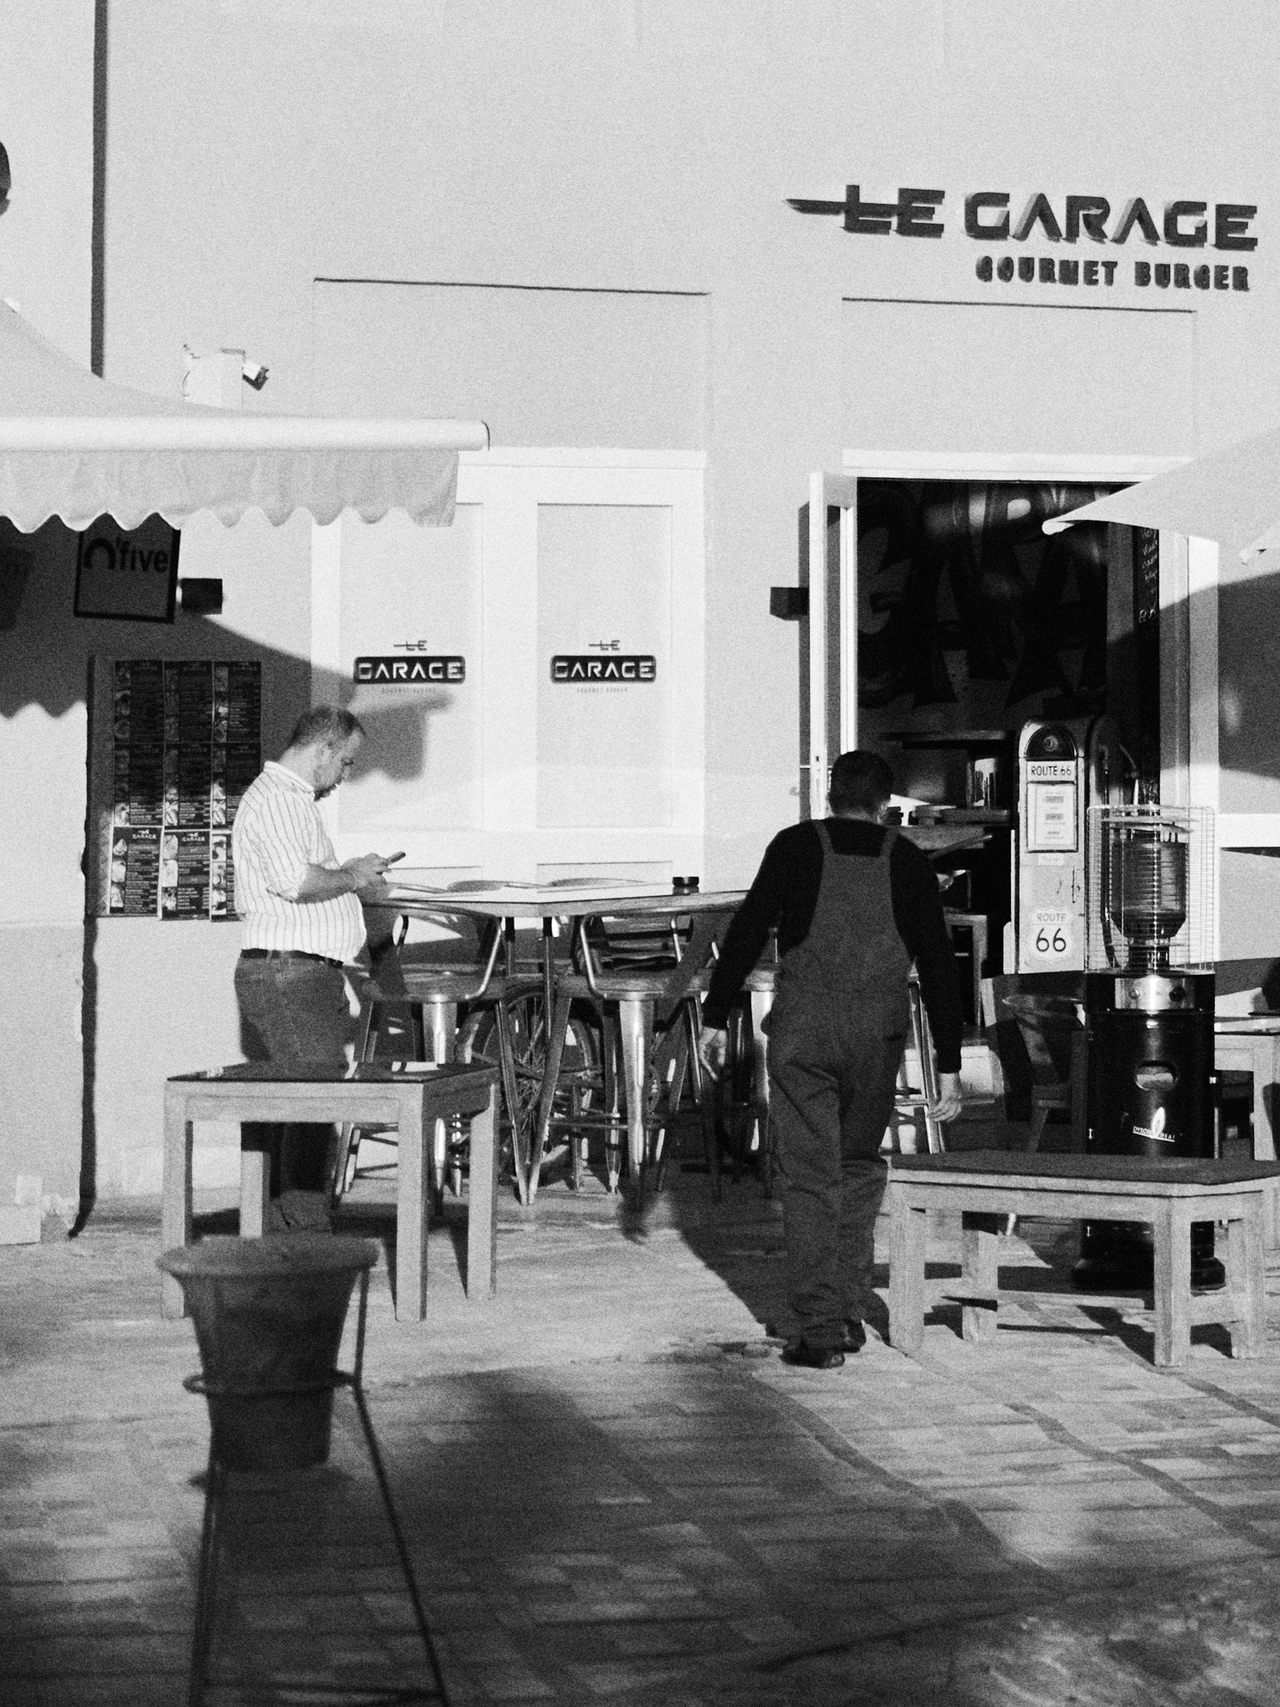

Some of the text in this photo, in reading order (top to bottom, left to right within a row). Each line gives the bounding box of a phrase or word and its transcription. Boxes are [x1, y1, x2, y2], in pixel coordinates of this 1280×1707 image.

[784, 184, 1259, 251] LE GARAGE
[975, 255, 1251, 292] GOURMET BURGER
[358, 662, 464, 680] GARAGE
[554, 661, 655, 679] GARAGE
[1031, 765, 1072, 776] ROUTE 66
[1036, 912, 1067, 922] ROUTE
[1035, 927, 1067, 953] 66
